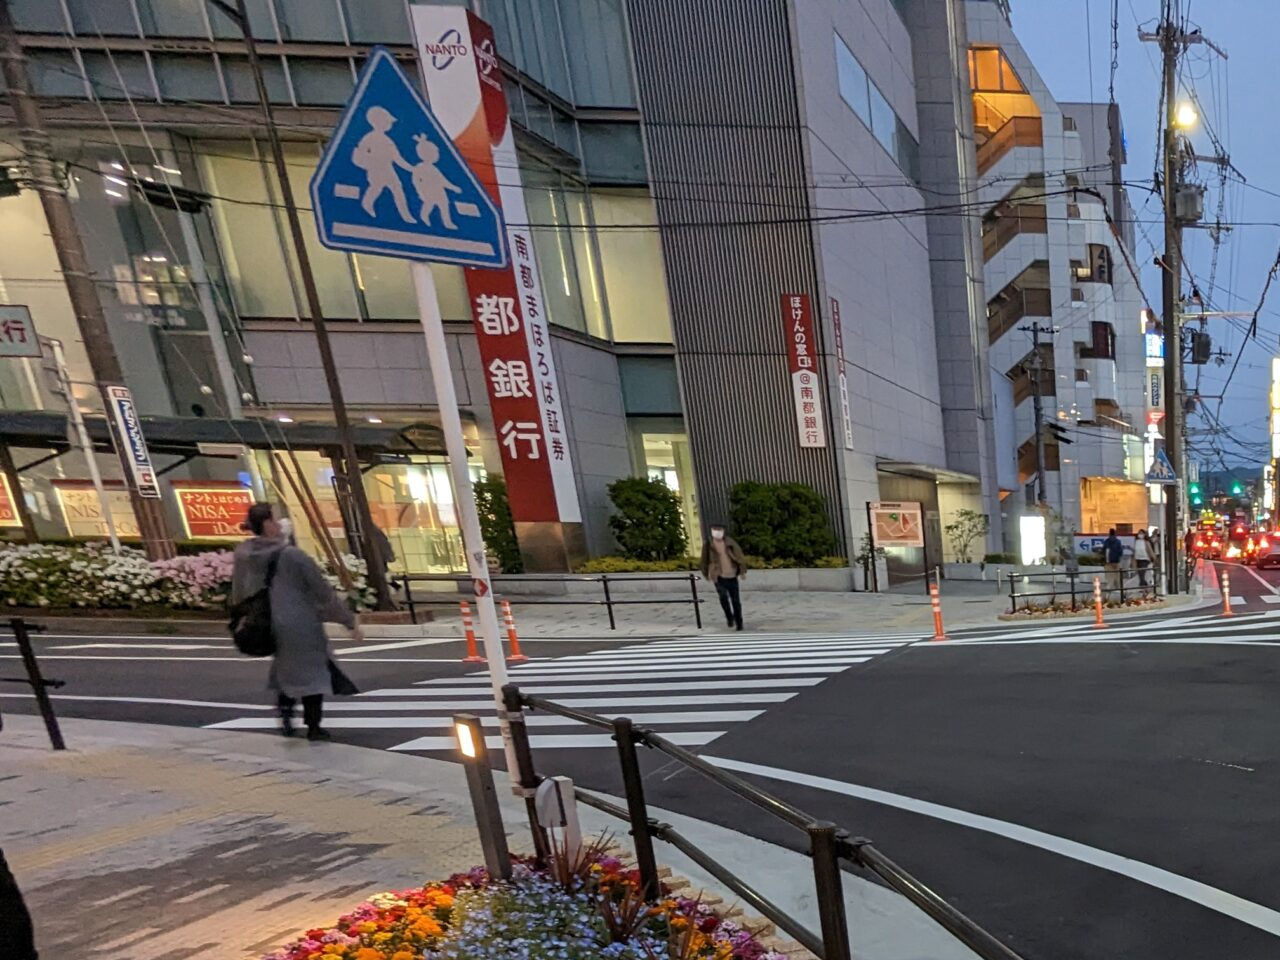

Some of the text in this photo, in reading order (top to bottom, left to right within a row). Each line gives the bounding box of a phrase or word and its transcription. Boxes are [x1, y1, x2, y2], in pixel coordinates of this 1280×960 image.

[425, 43, 467, 58] NANTO
[0, 319, 27, 344] 行
[790, 296, 811, 367] ほけんの窓口
[513, 233, 565, 462] 南都まほろば証券
[475, 293, 542, 460] 都銀行
[66, 504, 99, 518] NIS
[187, 505, 231, 519] NISA
[213, 521, 249, 535] iDeC
